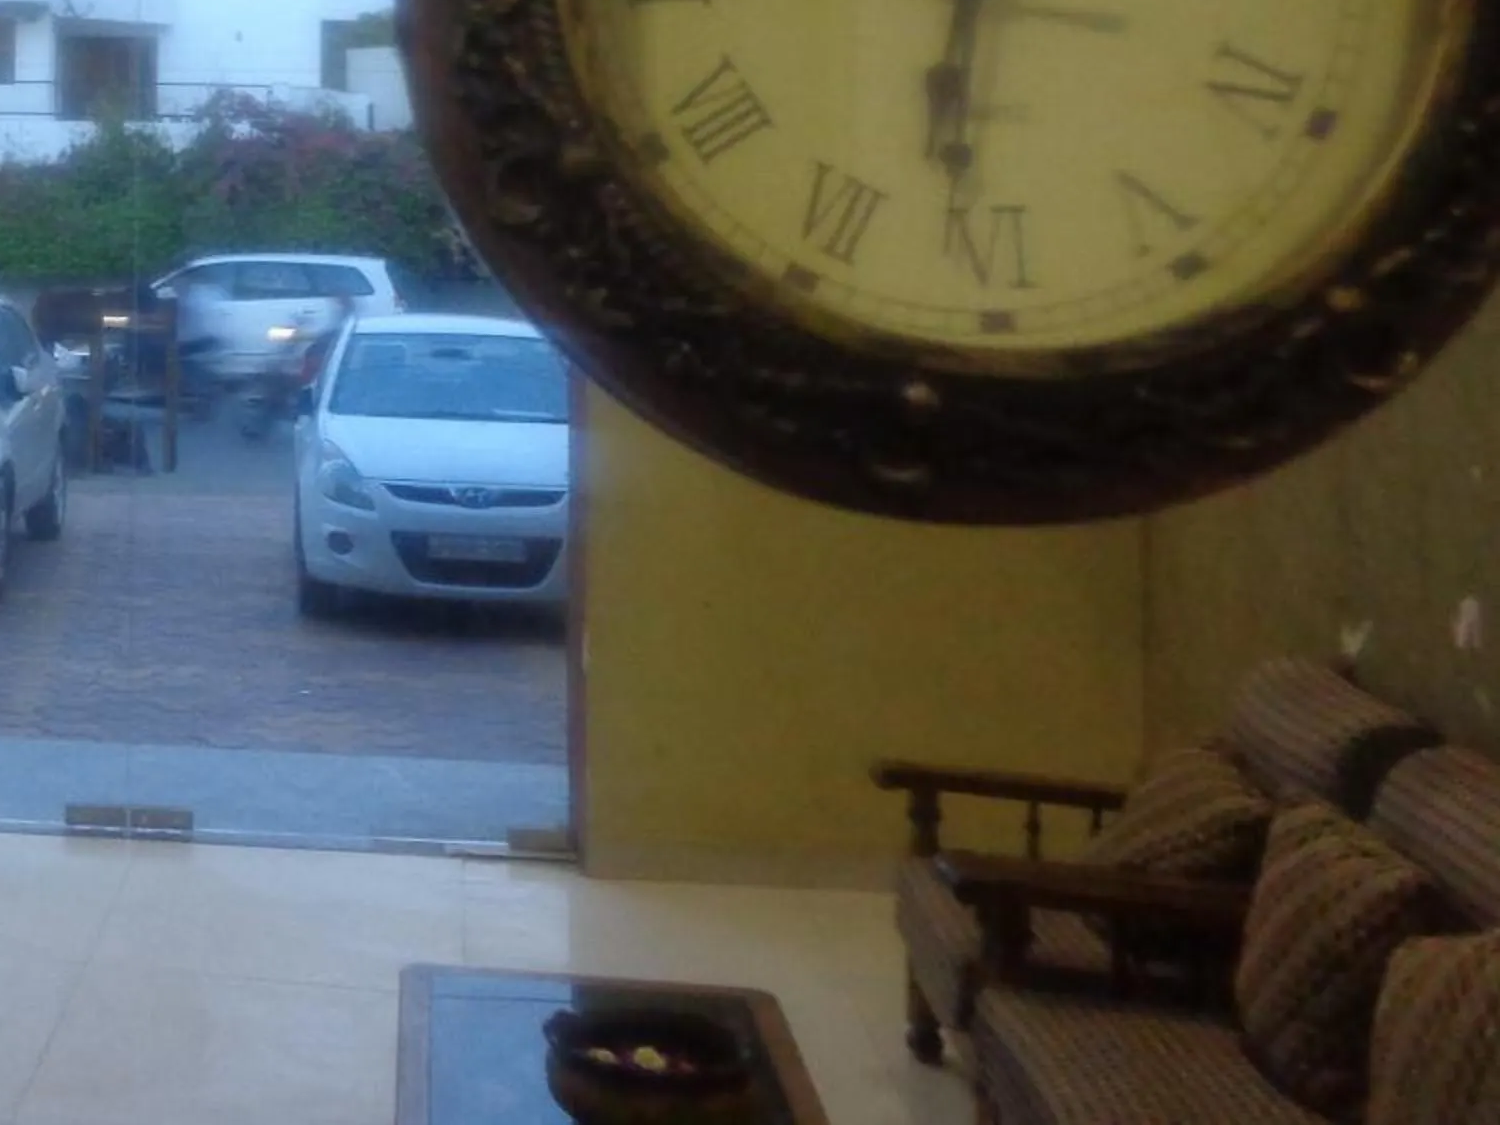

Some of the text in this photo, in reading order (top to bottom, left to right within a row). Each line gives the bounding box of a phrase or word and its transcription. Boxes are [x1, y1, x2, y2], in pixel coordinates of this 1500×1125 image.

[670, 55, 775, 165] VIII
[1203, 41, 1304, 141] IV
[802, 160, 890, 266] VII
[946, 202, 1036, 288] VI
[1112, 171, 1201, 258] V
